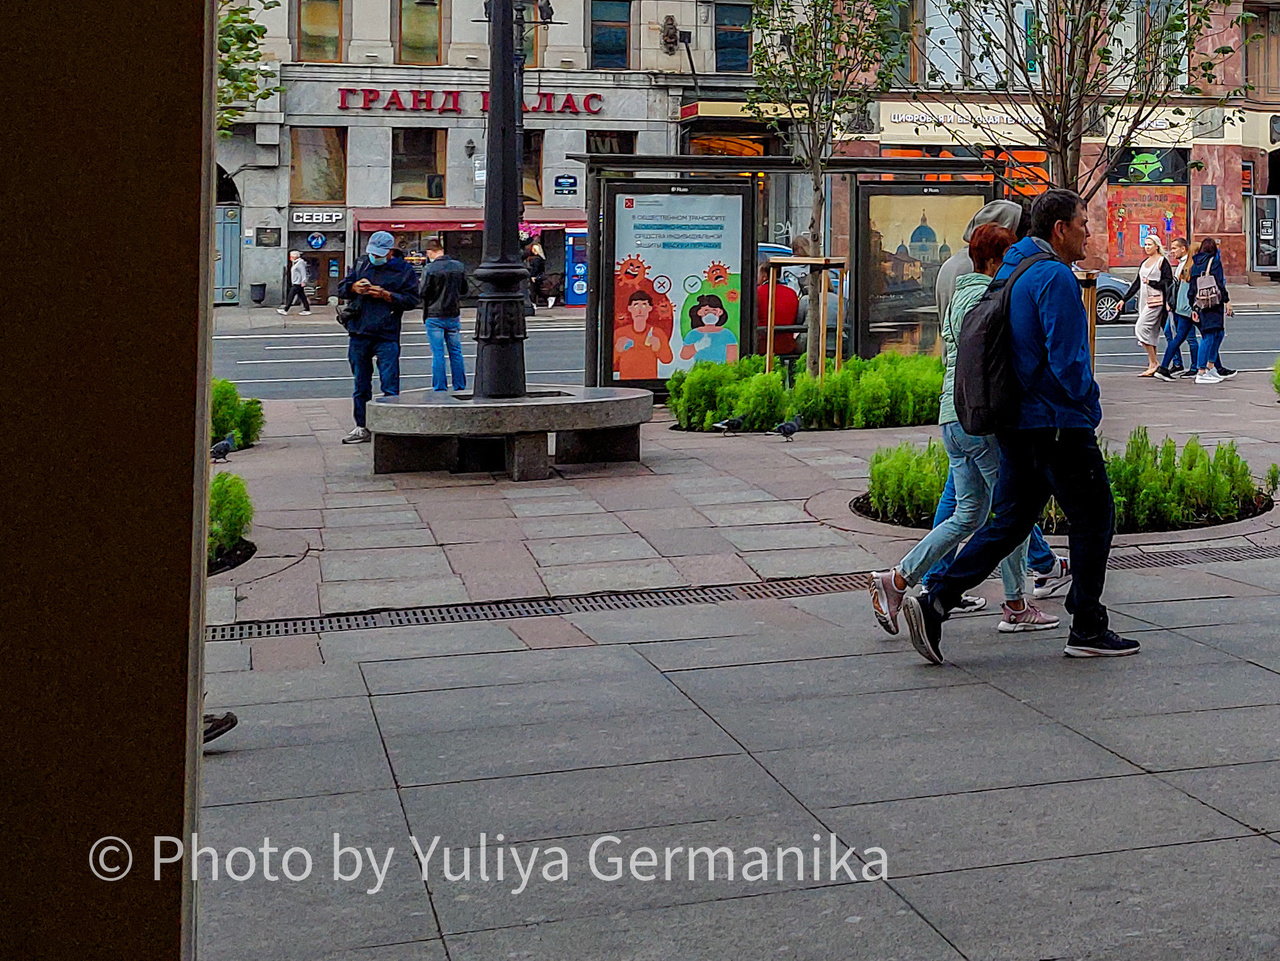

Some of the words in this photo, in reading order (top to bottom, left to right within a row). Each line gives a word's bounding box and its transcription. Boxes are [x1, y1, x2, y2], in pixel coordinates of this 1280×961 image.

[338, 88, 462, 114] ГРАНД
[481, 90, 603, 114] ЛАС
[890, 112, 944, 124] ЦИФРОВЯ
[947, 114, 955, 123] И
[957, 114, 1000, 125] БЫОВАЯ
[293, 212, 343, 223] СЕВЕР
